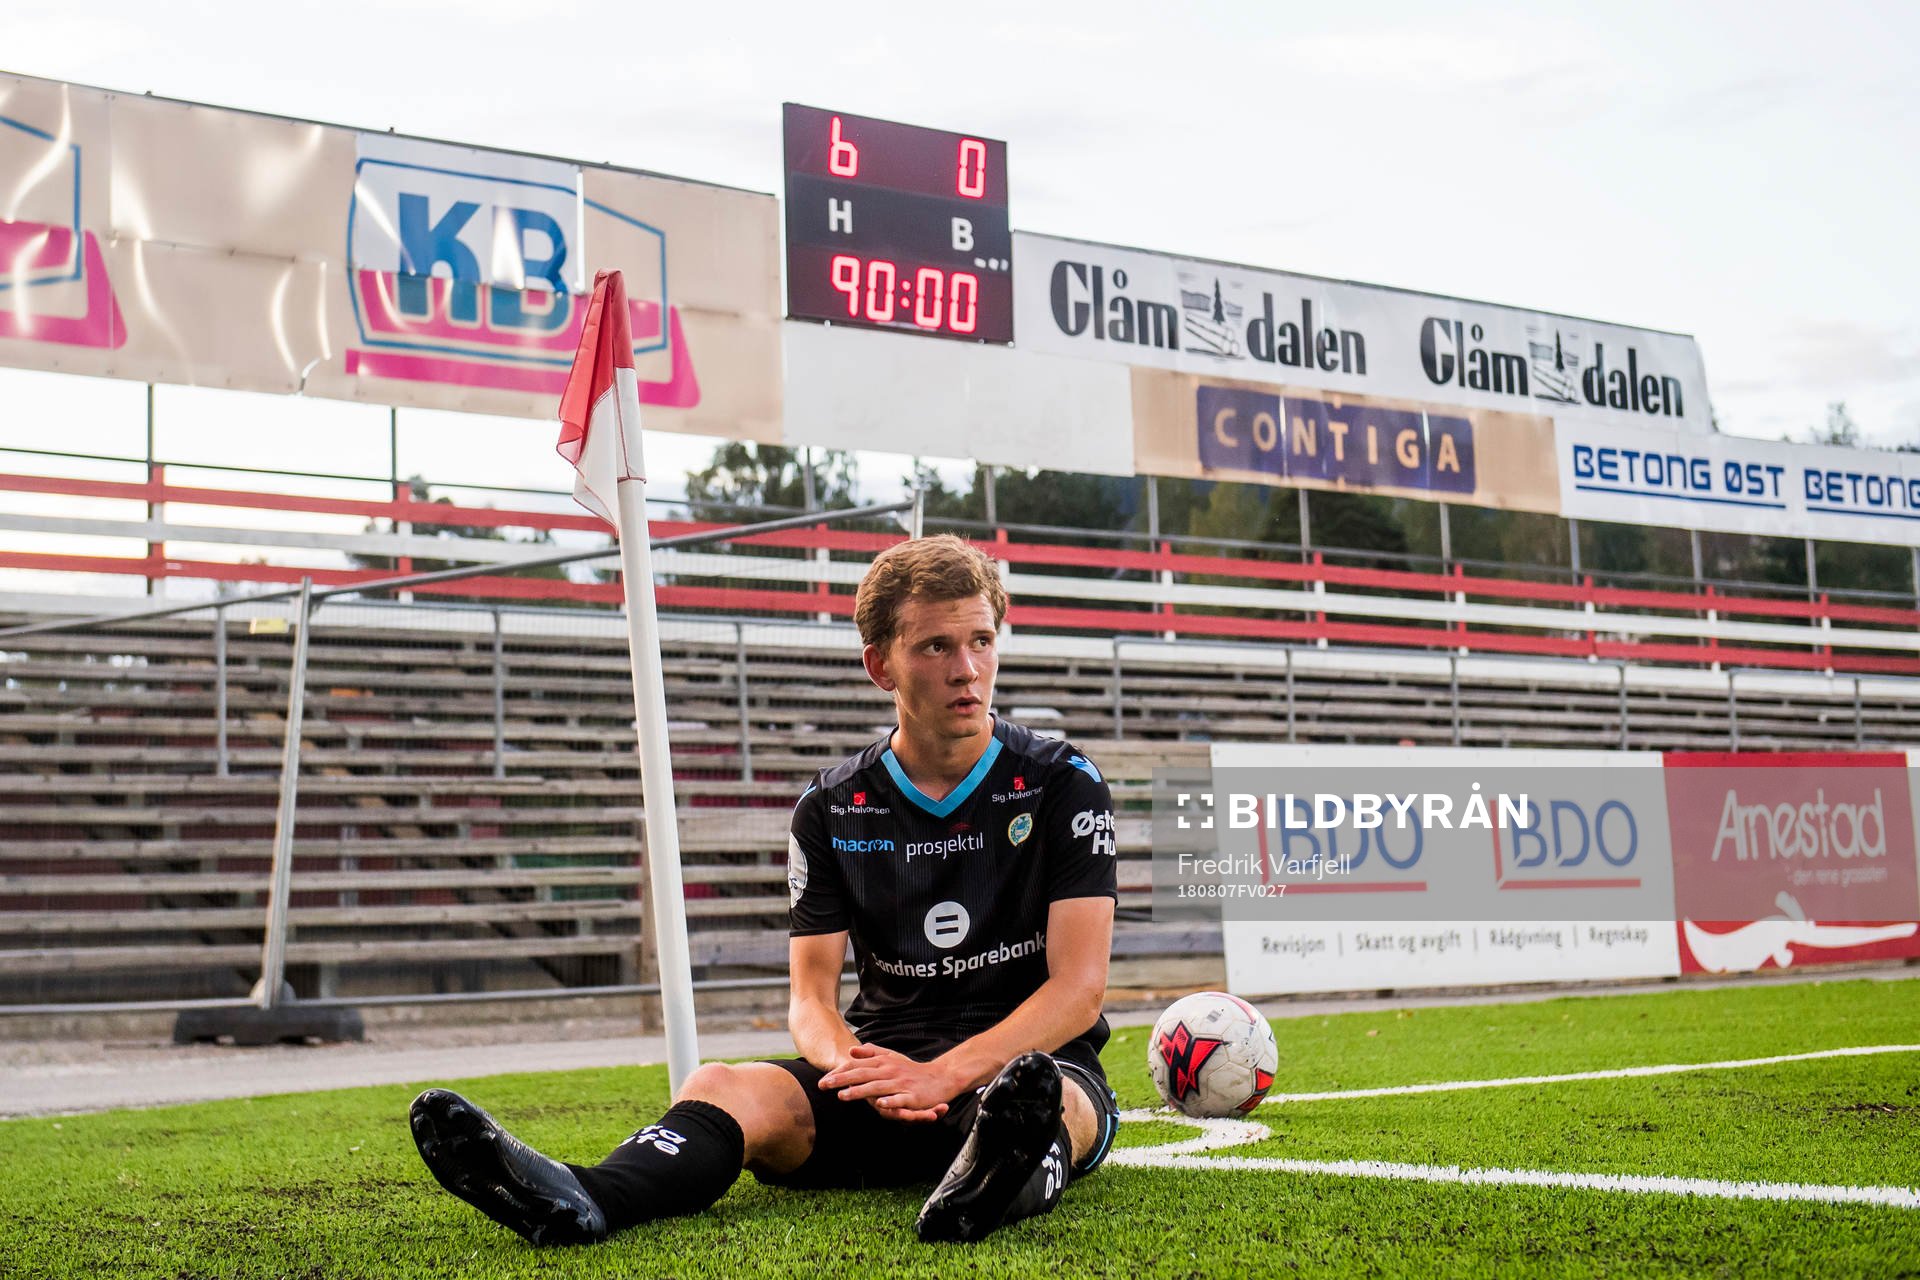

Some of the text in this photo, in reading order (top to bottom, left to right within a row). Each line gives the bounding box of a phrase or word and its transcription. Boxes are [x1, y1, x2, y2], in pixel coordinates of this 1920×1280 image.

[957, 139, 986, 199] 0
[828, 197, 974, 251] H B
[397, 192, 569, 332] KB
[831, 255, 978, 333] 90:00
[1247, 292, 1367, 376] dalen
[1582, 342, 1685, 419] dalen
[1214, 407, 1460, 473] CONTIGA
[1573, 444, 1785, 499] BETONG ØST
[832, 836, 895, 852] macron
[906, 832, 984, 863] prosjektil
[1277, 797, 1424, 870] BDO
[1510, 799, 1639, 868] BDO
[942, 931, 1047, 979] Sparebank
[1399, 935, 1415, 954] og
